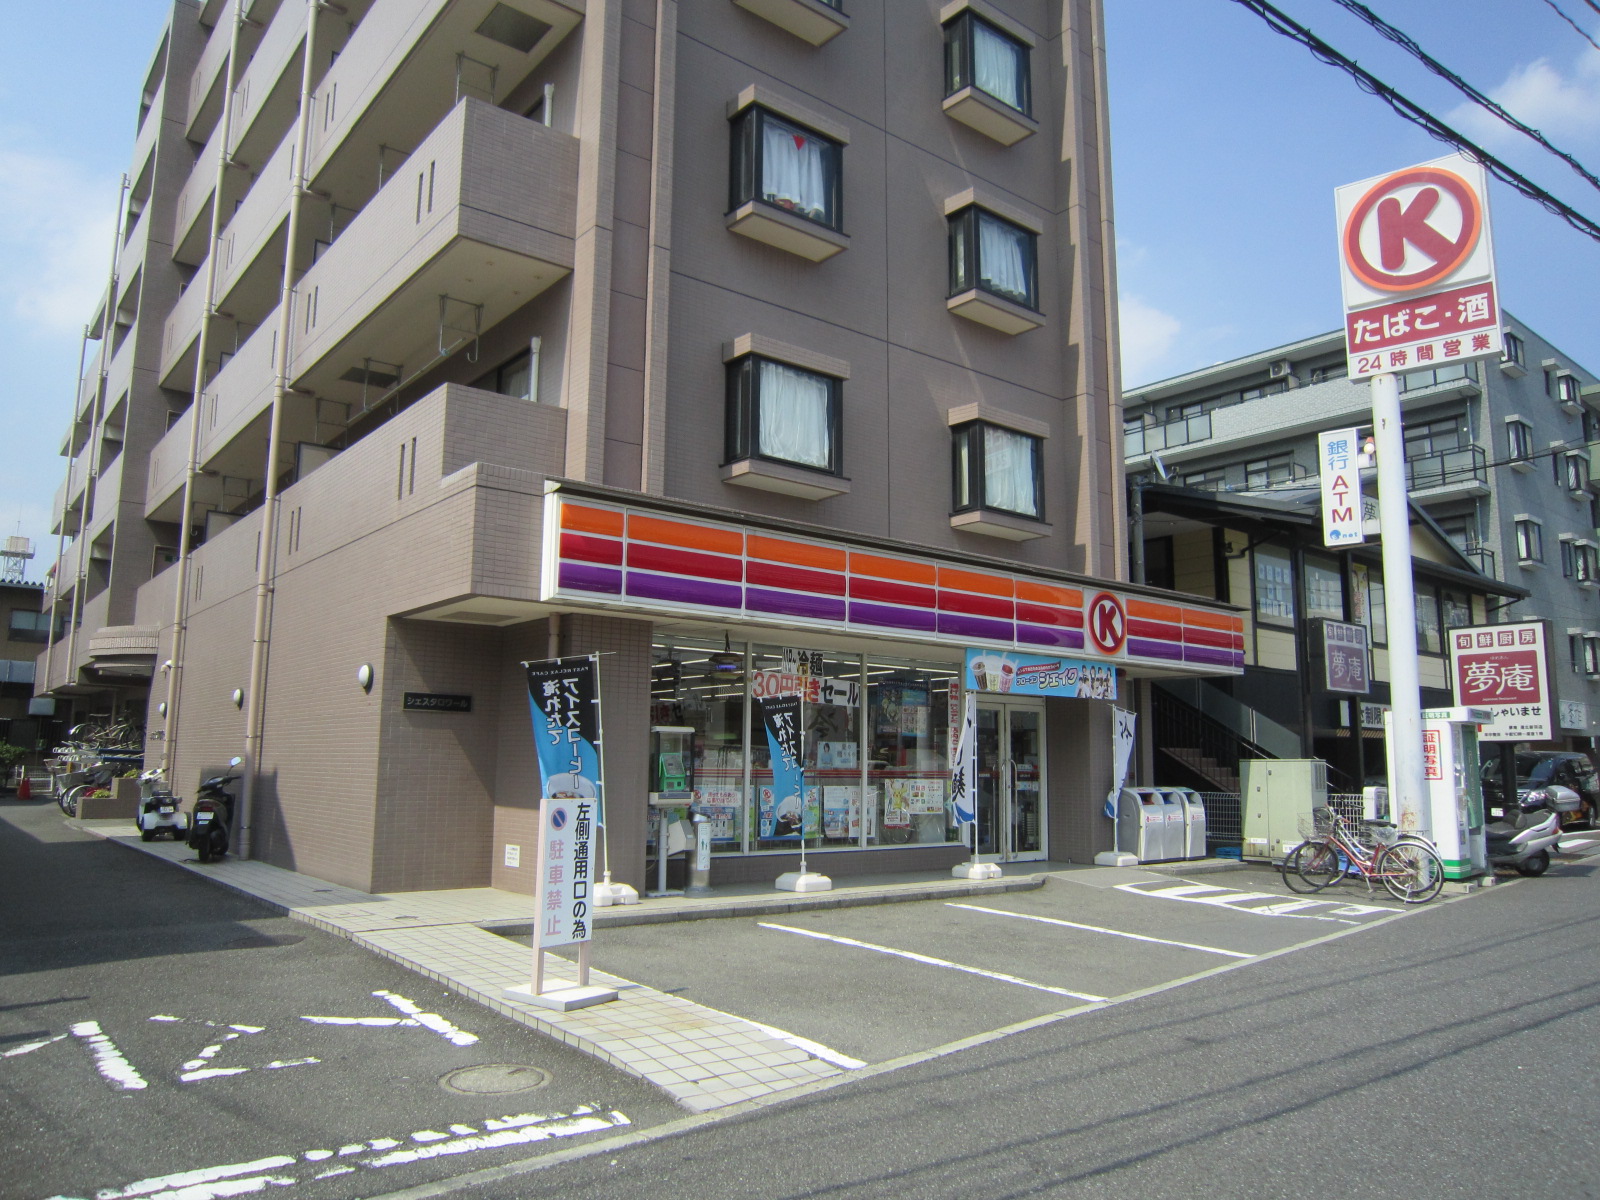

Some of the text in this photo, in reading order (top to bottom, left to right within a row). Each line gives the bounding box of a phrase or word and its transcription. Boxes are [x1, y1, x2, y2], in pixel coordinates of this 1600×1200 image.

[1377, 187, 1457, 270] K
[1353, 292, 1490, 344] たばこ・酒
[1357, 333, 1491, 374] 24時間営業
[1327, 439, 1353, 524] 銀行 ATM
[1099, 603, 1121, 645] K
[1457, 629, 1536, 649] 旬鮮厨房
[752, 671, 859, 706] 30円引きセール
[1039, 667, 1078, 689] シェイク
[1463, 660, 1535, 695] 夢庵
[1422, 733, 1438, 777] 証明写真
[545, 839, 565, 936] 駐車禁止
[572, 802, 591, 939] 左側通用口の為
